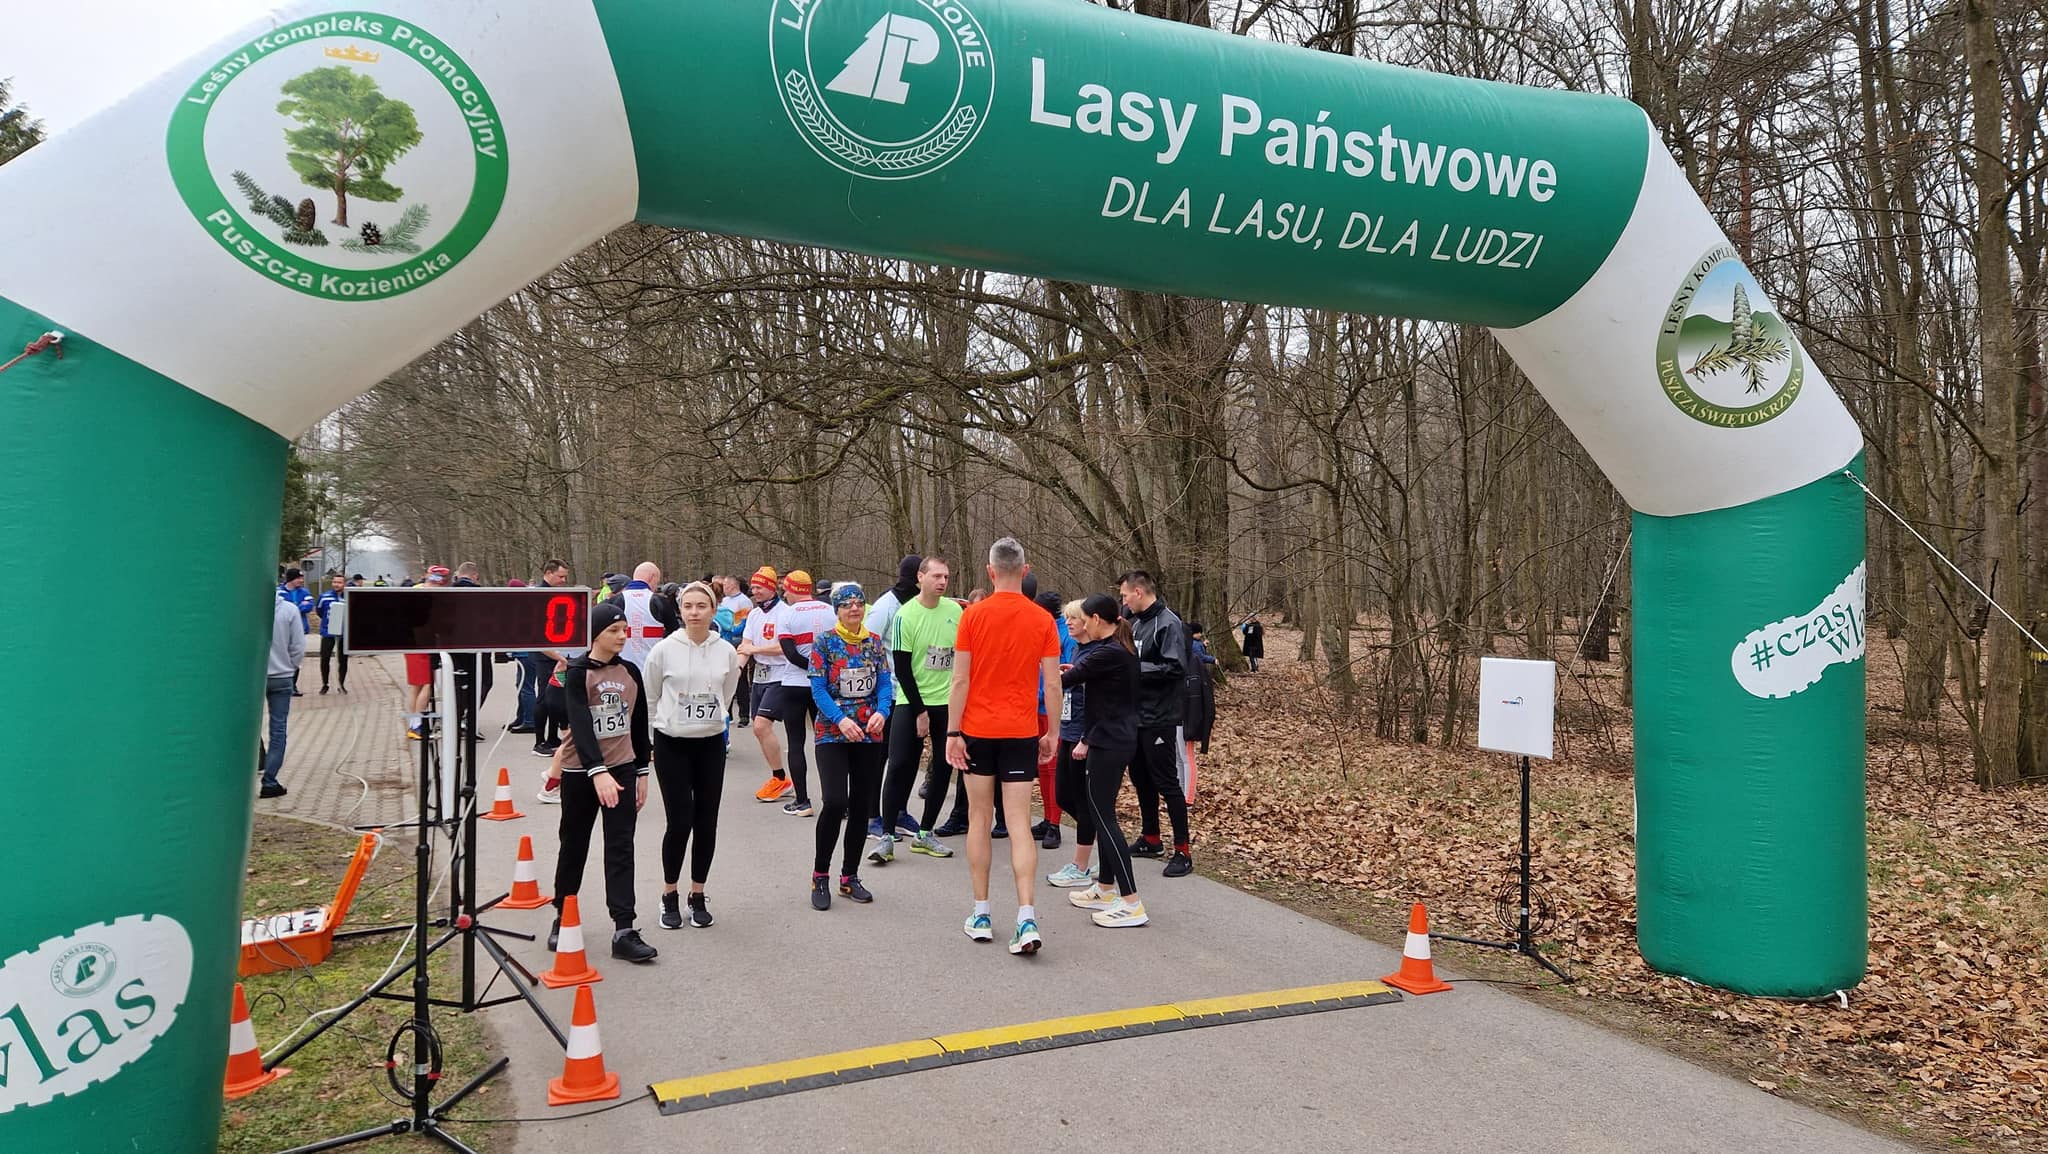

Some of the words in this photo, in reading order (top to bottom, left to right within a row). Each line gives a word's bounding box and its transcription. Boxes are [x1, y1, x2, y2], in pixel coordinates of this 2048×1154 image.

[187, 51, 251, 105] Leśny
[254, 15, 384, 53] Kompleks
[391, 24, 498, 159] Promocyjny
[1030, 57, 1197, 165] Lasy
[1220, 93, 1557, 202] Państwowe
[1101, 176, 1191, 228] DLA
[1208, 193, 1324, 251] LASU,
[1338, 212, 1419, 257] DLA
[1430, 224, 1544, 270] LUDZI
[207, 208, 314, 289] Puszcza
[319, 251, 451, 296] Kozienicka
[1664, 281, 1695, 335] LEŚNY
[1661, 359, 1698, 414] PUSZCZA
[545, 596, 576, 643] 0
[1750, 603, 1846, 672] #czas
[846, 677, 873, 692] 120
[931, 655, 951, 667] 118
[594, 714, 625, 732] 154
[684, 704, 717, 719] 157
